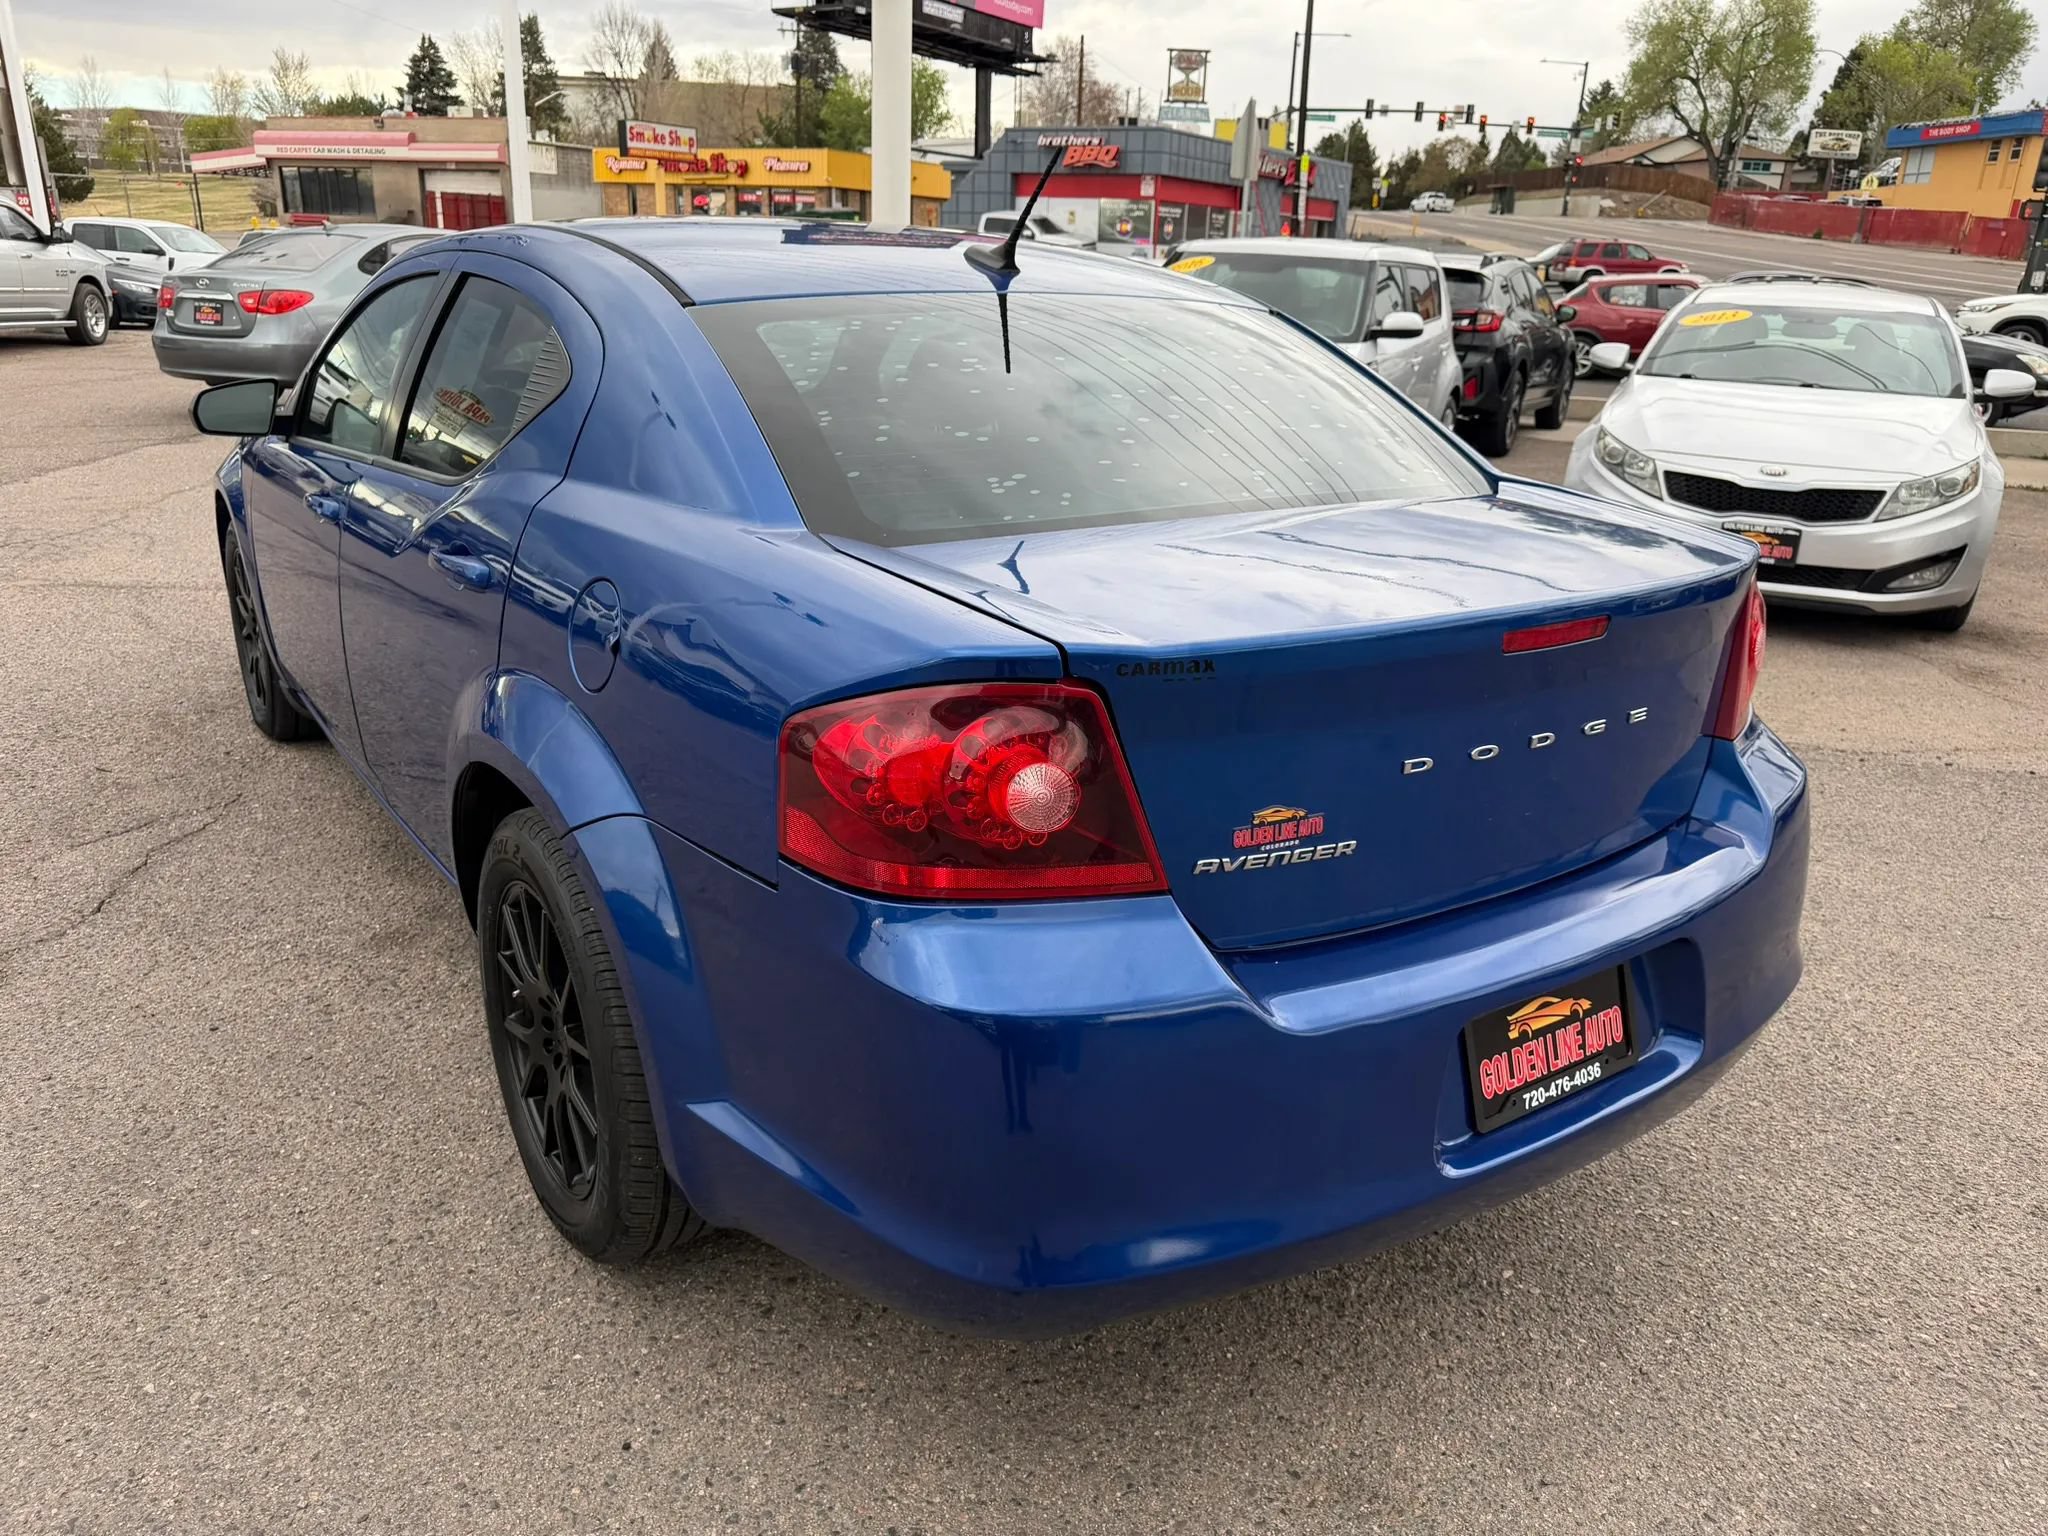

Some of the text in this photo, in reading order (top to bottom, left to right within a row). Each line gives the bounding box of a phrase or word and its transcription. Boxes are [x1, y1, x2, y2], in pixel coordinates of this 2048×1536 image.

[1928, 124, 1971, 137] THE BODY SHOP
[1037, 134, 1103, 146] brothers
[289, 146, 312, 154] CARPET
[352, 147, 386, 155] DETAILING
[1062, 145, 1120, 168] BBQ
[605, 156, 647, 174] Romance
[764, 156, 811, 173] Pleasures
[1723, 522, 1750, 531] GOLDEN
[1751, 524, 1765, 532] LINE
[1765, 526, 1784, 535] AUTO
[1773, 545, 1793, 559] AUTO
[1402, 707, 1648, 775] DODGE
[1233, 815, 1324, 849] GOLDEN LINE AUTO
[1260, 839, 1300, 851] COLORADO
[1193, 840, 1357, 875] AVENGER
[1479, 1005, 1624, 1100] GOLDEN LINE AUTO
[1522, 1062, 1602, 1110] 720-476-4036
